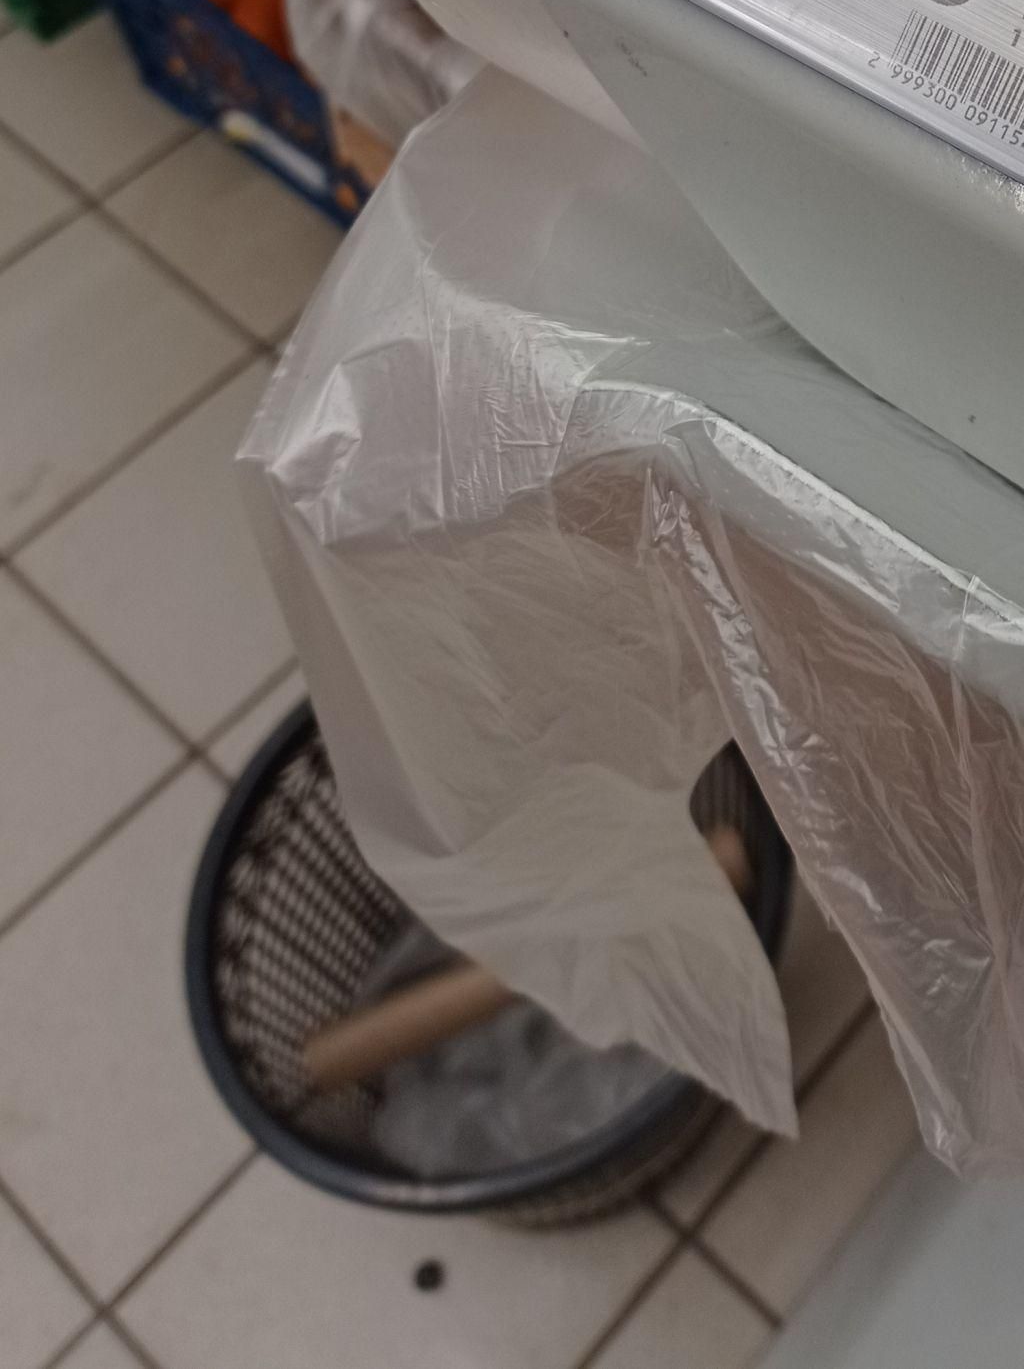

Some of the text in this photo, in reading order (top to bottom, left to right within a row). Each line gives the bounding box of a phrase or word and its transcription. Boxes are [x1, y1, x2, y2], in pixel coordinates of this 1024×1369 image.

[1011, 30, 1021, 48] 1
[867, 52, 881, 69] 2
[891, 66, 958, 111] 999300
